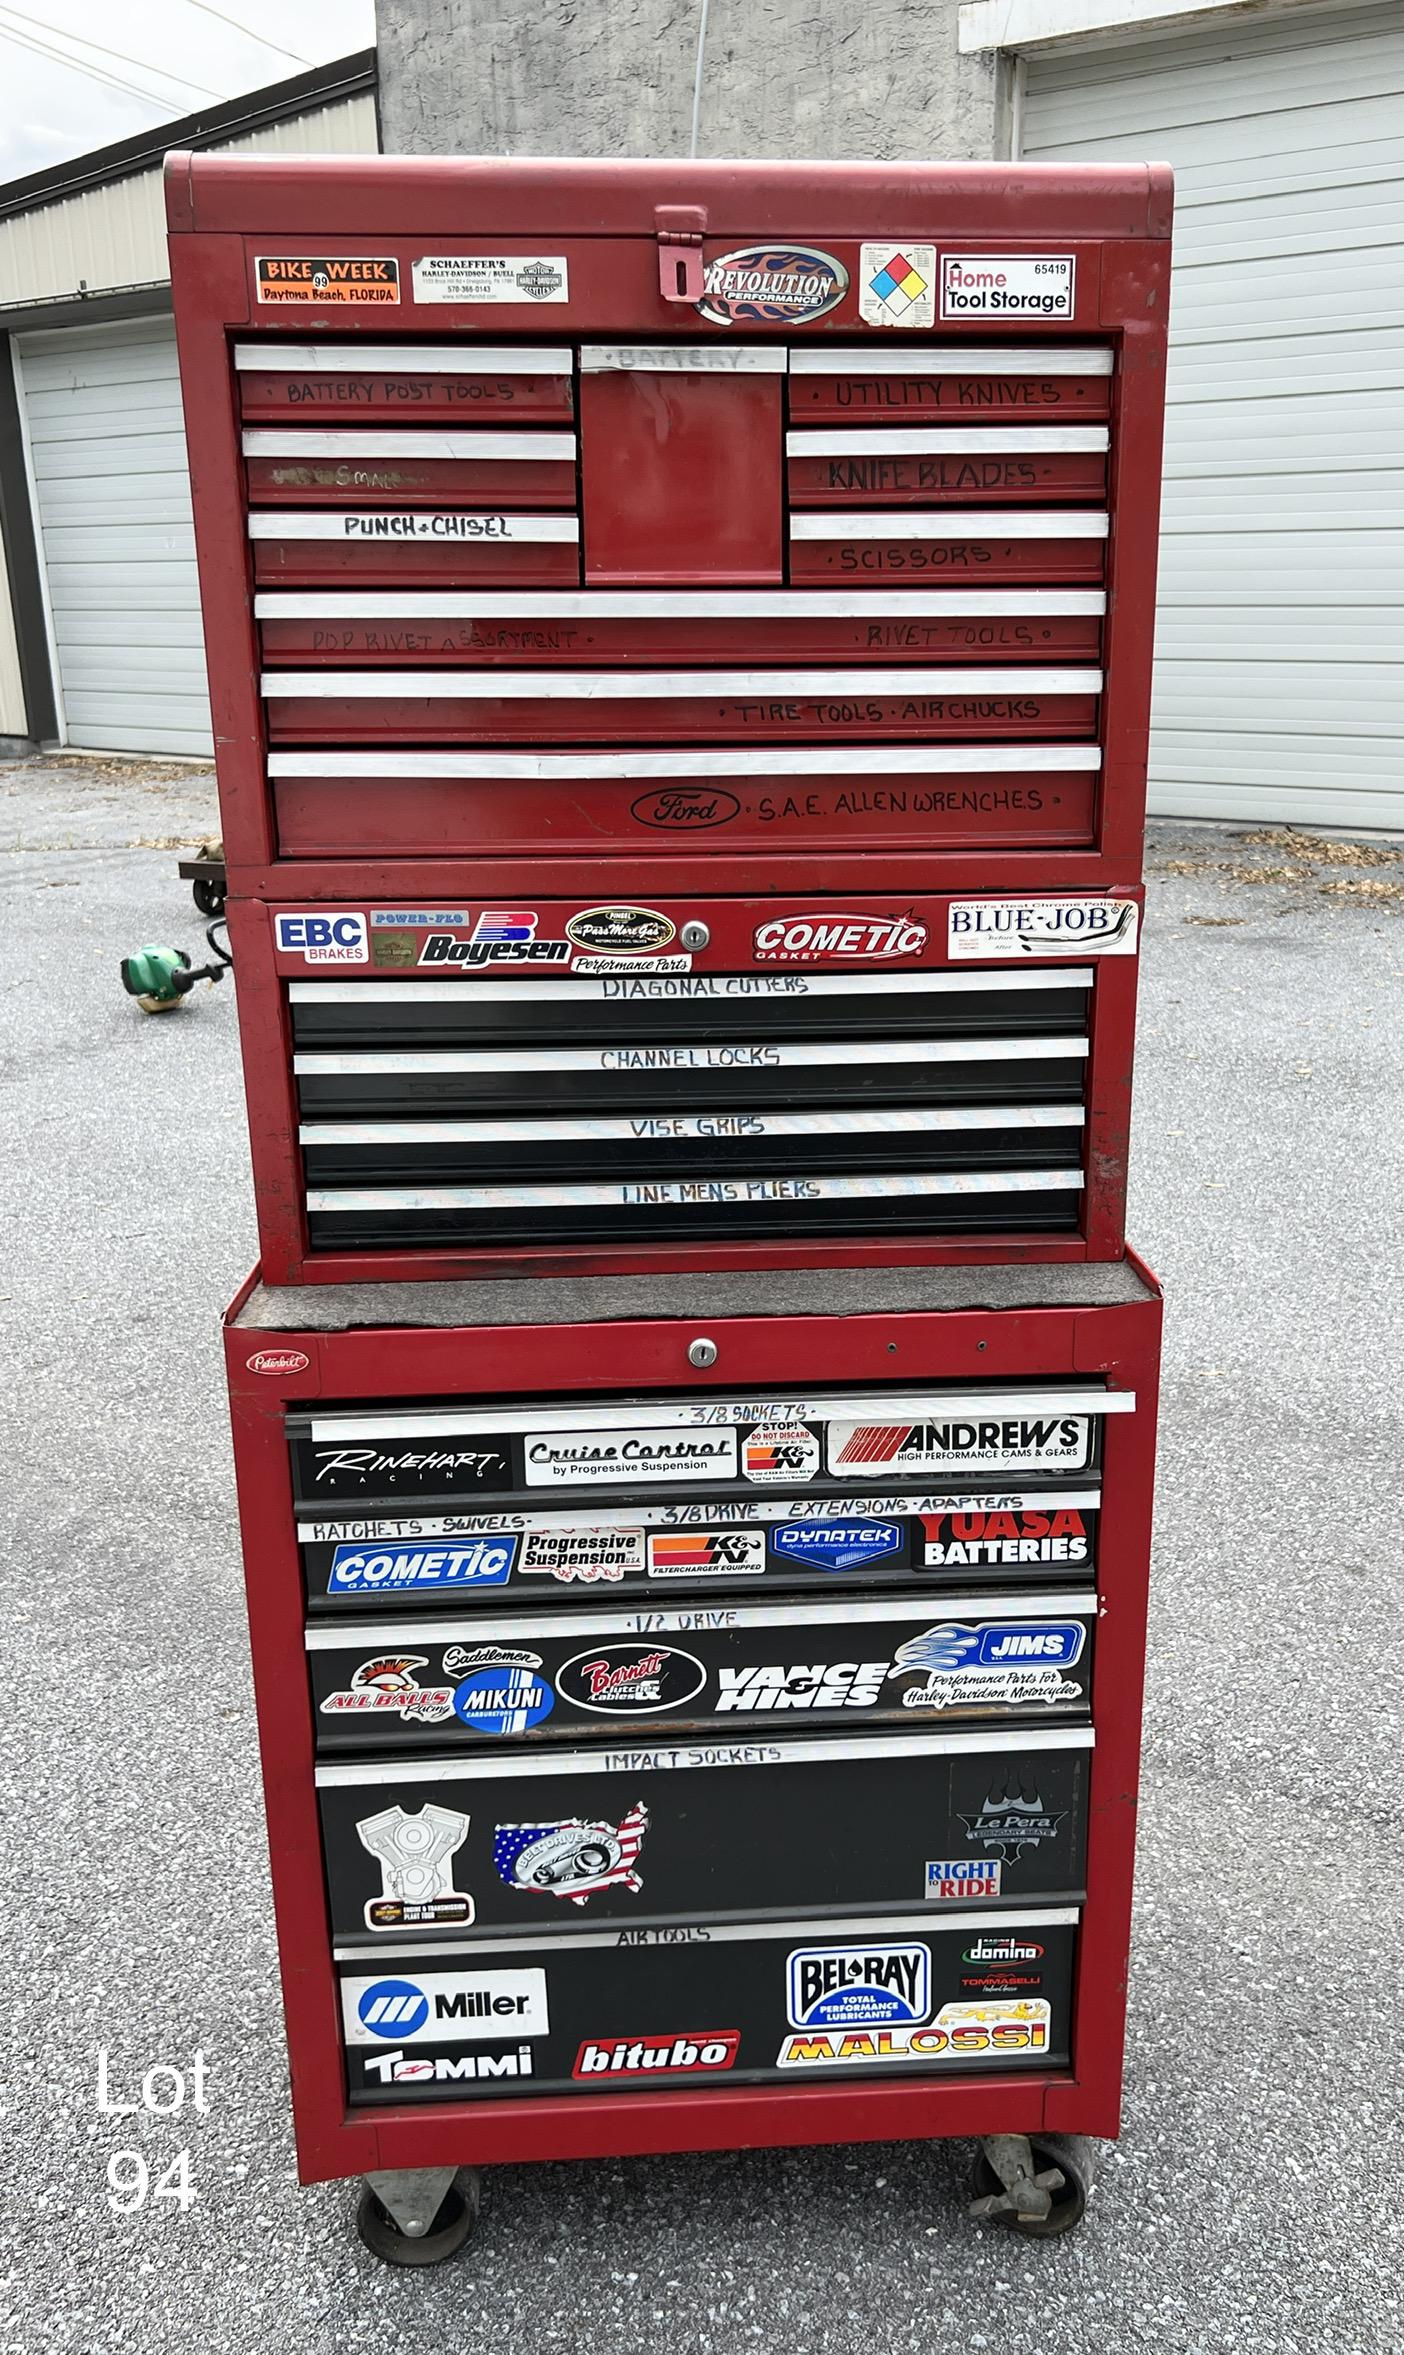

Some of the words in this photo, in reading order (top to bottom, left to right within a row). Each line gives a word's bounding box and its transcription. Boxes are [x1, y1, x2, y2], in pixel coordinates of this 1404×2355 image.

[266, 262, 312, 278] BIKE
[326, 262, 388, 280] WEEK
[430, 260, 506, 269] SCHAEFFER'S
[1034, 264, 1067, 275] 65419
[314, 276, 328, 288] 99
[704, 267, 833, 297] REVOLUTION
[949, 270, 1007, 287] Home
[264, 288, 309, 301] Daytona
[350, 289, 393, 301] FLORIDA
[727, 293, 819, 304] PERFORMANCE
[948, 291, 986, 308] Tool
[990, 291, 1067, 312] Storage
[287, 383, 374, 402] BATTERY
[385, 383, 433, 400] POST
[441, 383, 515, 400] TOOLS
[836, 381, 944, 405] UTILITY
[957, 383, 1061, 404] KNIVES
[827, 461, 912, 490] KNIFE
[918, 461, 1037, 489] BLADES
[840, 546, 993, 569] SCISSORS
[366, 632, 433, 651] RIVET
[866, 626, 938, 646] RIVET
[947, 626, 1033, 646] TOOLS
[734, 704, 802, 722] TIRE
[812, 704, 884, 722] TOOLS
[653, 793, 718, 821] Ford
[834, 792, 908, 814] ALLEN
[280, 918, 362, 947] EBC
[582, 924, 609, 937] Pass
[609, 923, 638, 936] More
[638, 922, 660, 938] Gas
[756, 923, 926, 952] COMETIC
[309, 948, 363, 959] BRAKES
[422, 936, 569, 965] Boyesen
[755, 952, 821, 960] GASKET
[576, 957, 655, 975] Performance
[655, 958, 688, 971] Parts
[603, 978, 721, 998] DIAGONAL
[725, 976, 809, 994] CUTTERS
[600, 1049, 700, 1069] CHANNEL
[707, 1047, 781, 1067] LOCKS
[630, 1119, 688, 1137] VISE
[697, 1116, 765, 1136] GRIPS
[622, 1185, 674, 1204] LINE
[746, 1181, 821, 1200] PLIERS
[255, 1356, 303, 1370] Peterbilt
[690, 1406, 728, 1424] 3/8
[732, 1404, 807, 1422] SOCKETS
[762, 1421, 798, 1431] STOP!
[780, 1431, 810, 1439] DISCARD
[898, 1419, 1079, 1452] ANDREWS
[530, 1443, 618, 1463] Cruise
[622, 1440, 732, 1460] Control
[770, 1446, 814, 1469] K&N
[898, 1452, 922, 1461] HIGH
[925, 1450, 998, 1460] PERFORMANCE
[1001, 1449, 1032, 1458] CAMS
[1034, 1449, 1042, 1457] &
[1045, 1447, 1078, 1456] GEARS
[553, 1466, 566, 1476] by
[570, 1463, 638, 1475] Progressive
[641, 1461, 708, 1473] Suspension
[313, 1520, 423, 1540] RATCHETS
[442, 1516, 526, 1532] SWIVELS
[661, 1506, 702, 1524] 3/8
[705, 1503, 760, 1521] DRIVE
[788, 1497, 908, 1516] EXTENSIONS
[917, 1508, 1087, 1541] YUASA
[527, 1534, 636, 1550] Progressive
[781, 1529, 892, 1542] DYNATEK
[703, 1535, 761, 1563] K&N
[924, 1537, 1088, 1566] BATTERIES
[335, 1548, 508, 1582] COMETIC
[525, 1551, 626, 1568] Suspension
[653, 1566, 719, 1574] FILTERCHARGER
[721, 1564, 761, 1572] EQUIPPED
[347, 1579, 413, 1588] GASKET
[636, 1614, 669, 1632] 1/2
[678, 1612, 741, 1630] DRIVE
[990, 1634, 1064, 1657] JIMS
[445, 1647, 540, 1667] Saddlemen
[581, 1652, 672, 1694] Barnett
[718, 1663, 891, 1690] VANCE
[932, 1674, 1004, 1689] Performance
[1007, 1671, 1037, 1685] Parts
[1039, 1671, 1057, 1683] For
[326, 1693, 371, 1708] ALL
[374, 1690, 450, 1706] BALLS
[463, 1688, 543, 1711] MIKUNI
[714, 1685, 881, 1711] HINES
[907, 1687, 1006, 1704] Harley-Davidson
[1010, 1684, 1077, 1700] Motorcycles
[404, 1702, 450, 1717] Racing
[605, 1751, 680, 1770] IMPACT
[688, 1747, 782, 1766] SOCKETS
[974, 1817, 1000, 1829] Le
[1003, 1816, 1051, 1828] Pera
[519, 1844, 544, 1868] BELT
[544, 1833, 591, 1849] DRIVES
[928, 1861, 998, 1880] RIGHT
[940, 1878, 998, 1897] RIDE
[970, 1938, 1036, 1959] domino
[962, 1977, 1040, 1986] TOMMASELLI
[434, 1991, 529, 2019] Miller
[819, 2001, 899, 2013] PERFORMANCE
[842, 1995, 876, 2004] TOTAL
[826, 2010, 892, 2021] LUBRICANTS
[786, 2024, 1046, 2061] MALOSSI
[581, 2040, 727, 2072] bitubo
